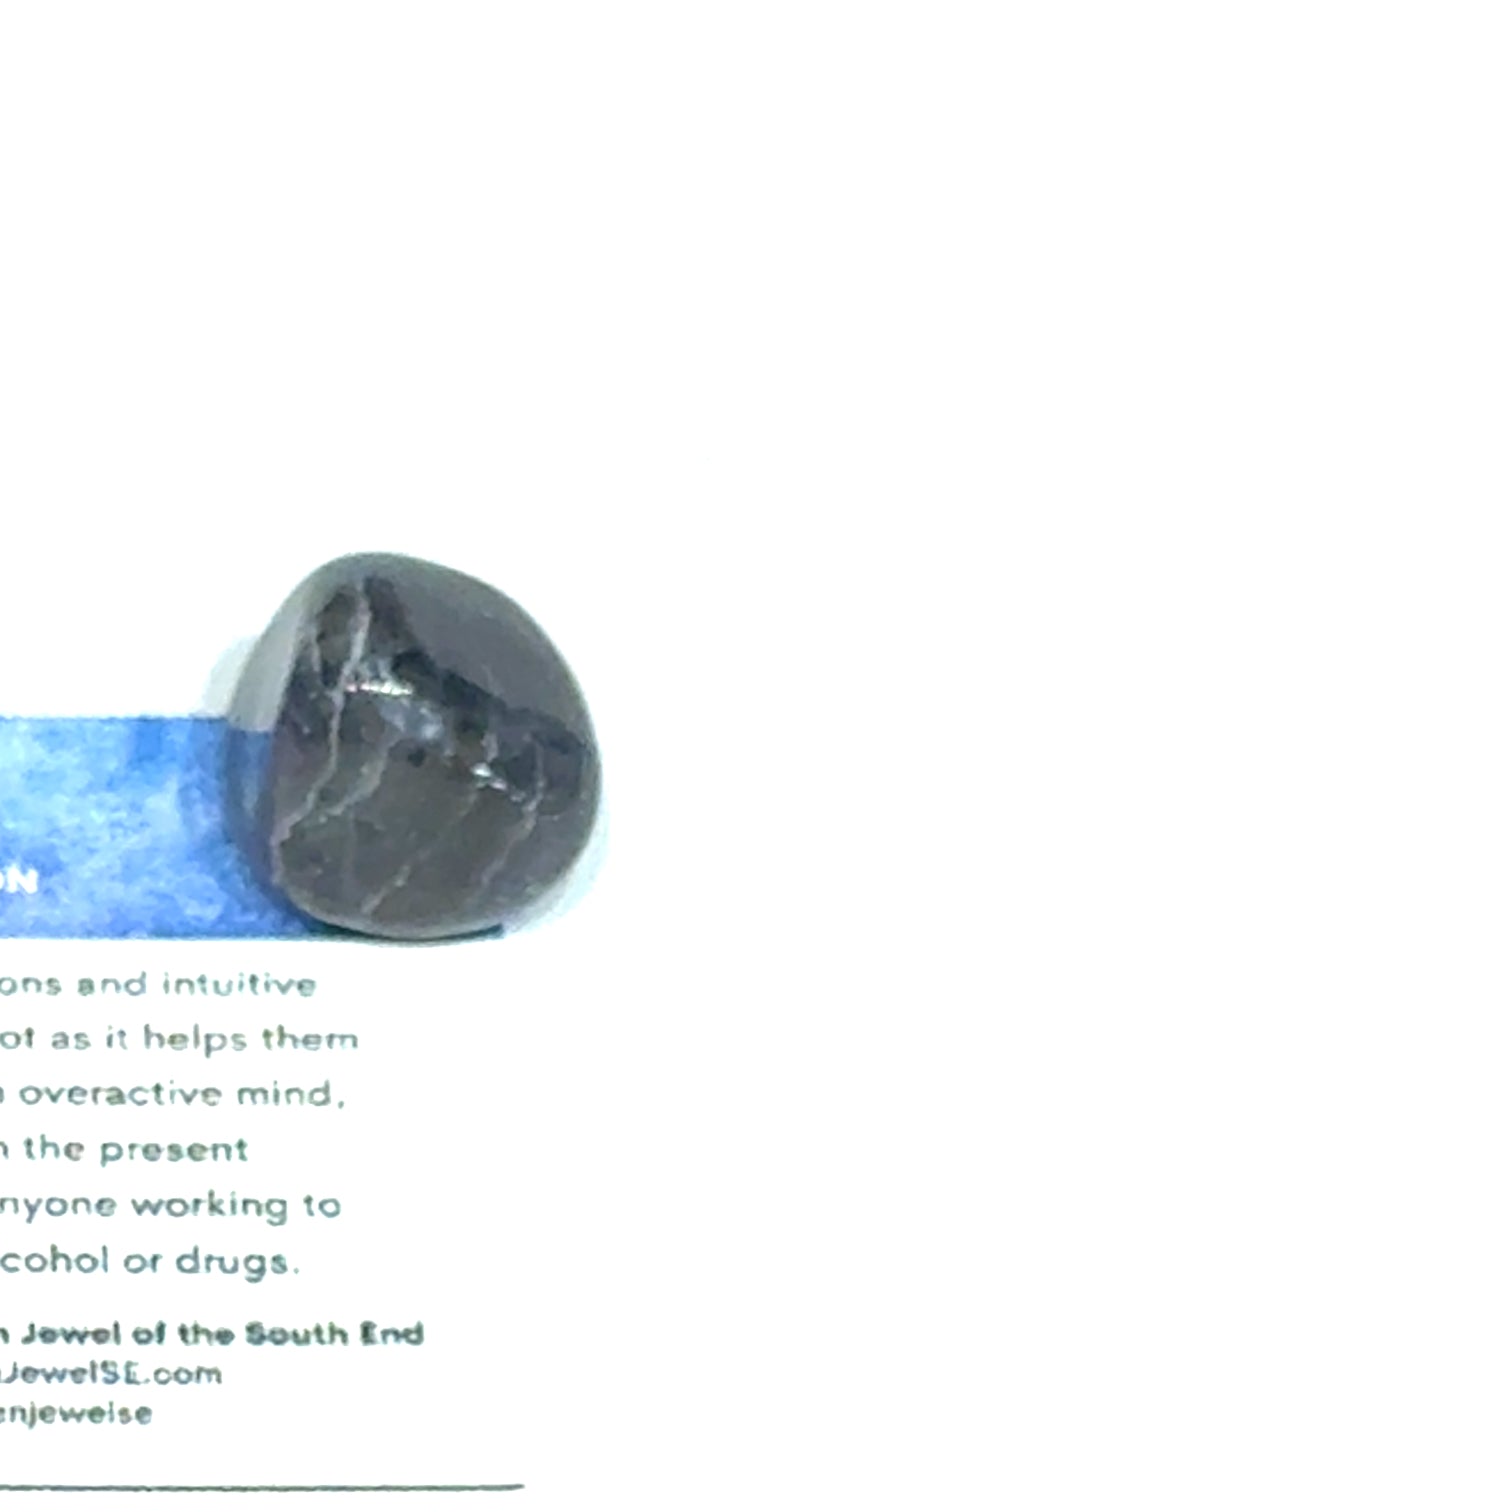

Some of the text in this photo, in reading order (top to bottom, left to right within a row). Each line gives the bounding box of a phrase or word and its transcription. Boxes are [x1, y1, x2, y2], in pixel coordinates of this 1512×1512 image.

[77, 970, 147, 997] and
[162, 972, 317, 998] intuitive
[51, 1031, 92, 1051] as
[106, 1029, 127, 1050] it
[143, 1023, 248, 1059] helps
[261, 1024, 359, 1052] them
[18, 1079, 223, 1107] overactive
[23, 1133, 85, 1162] the
[100, 1138, 248, 1168] present
[130, 1189, 288, 1227] working
[302, 1194, 341, 1219] to
[123, 1253, 163, 1275] or
[175, 1244, 300, 1284] drugs.
[20, 1320, 122, 1346] Jewel
[131, 1319, 167, 1346] of
[177, 1321, 236, 1347] the
[244, 1320, 349, 1347] South
[359, 1320, 425, 1347] End
